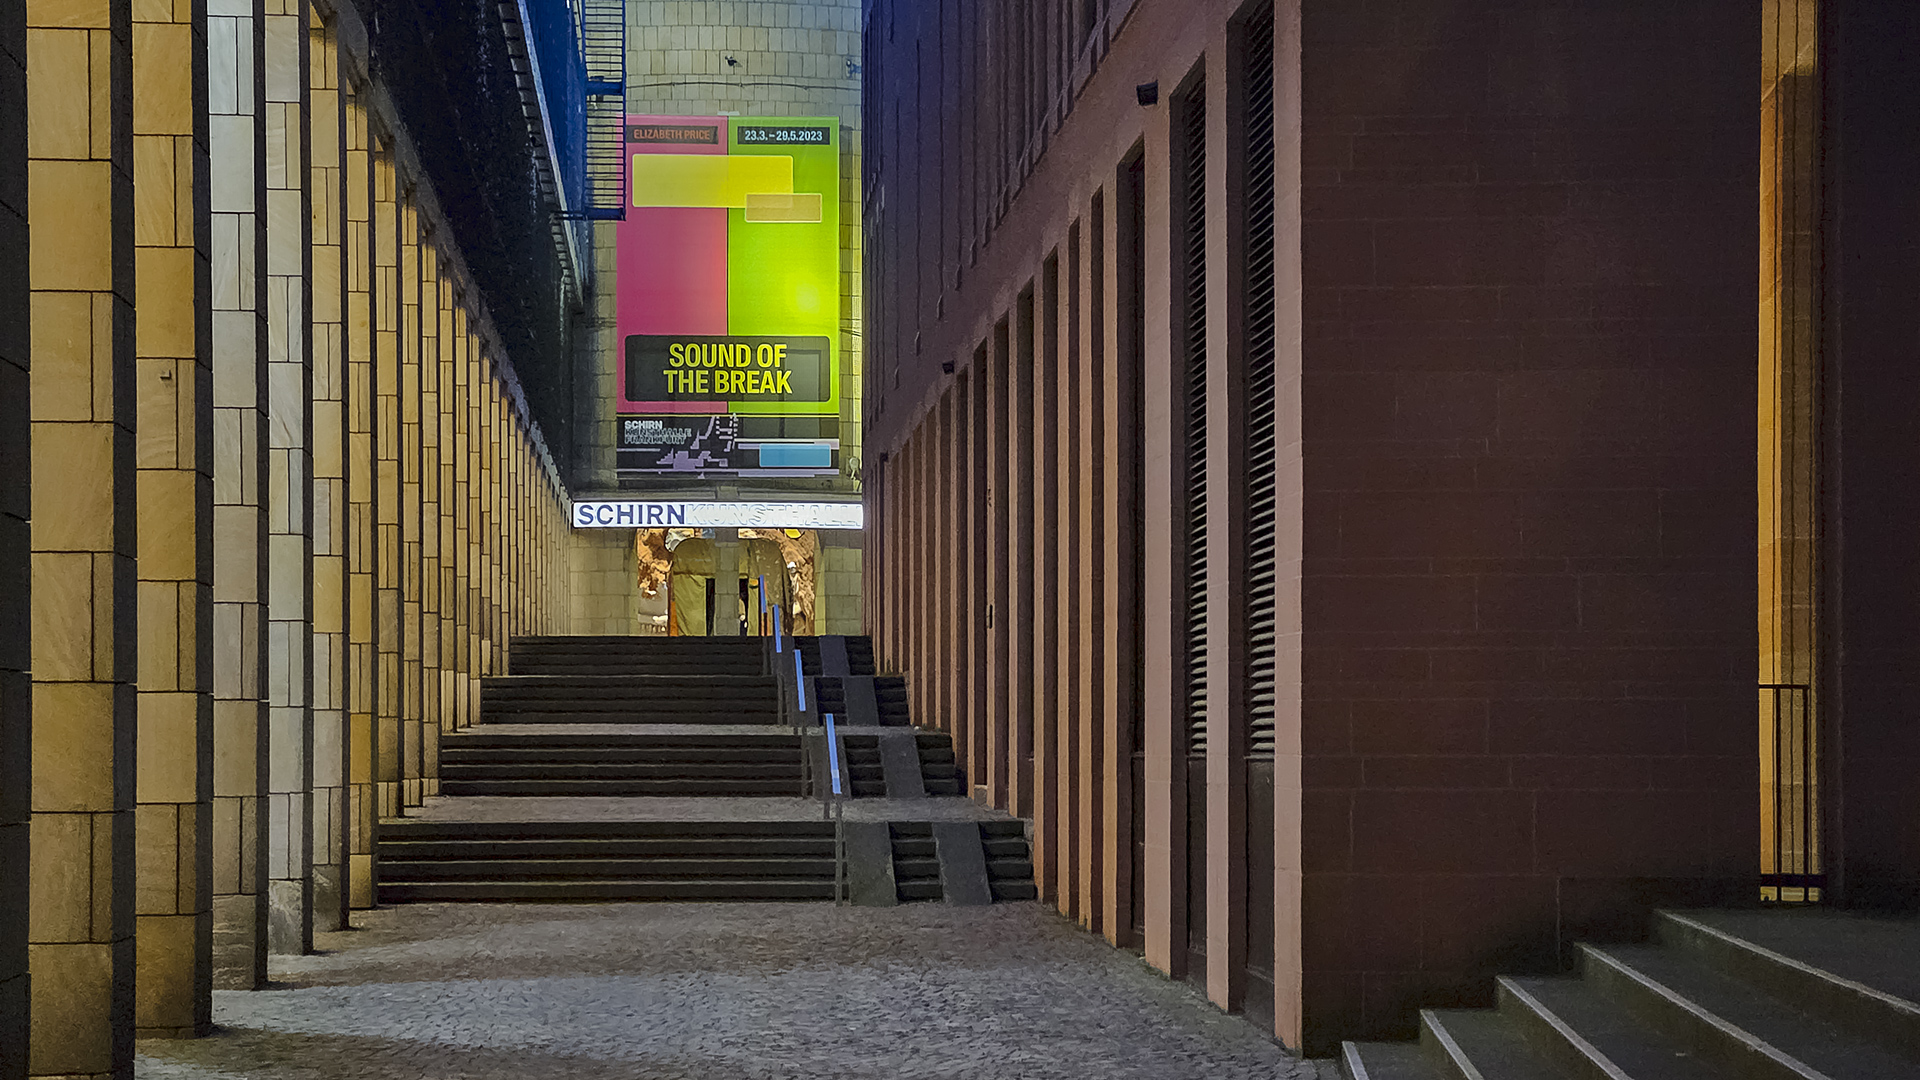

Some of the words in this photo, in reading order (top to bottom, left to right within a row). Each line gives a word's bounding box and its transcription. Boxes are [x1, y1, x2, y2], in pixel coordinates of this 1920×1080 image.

[633, 129, 682, 140] ELIZABETH
[683, 129, 711, 141] PRICE
[669, 343, 751, 368] SOUND
[756, 344, 788, 368] OF
[663, 370, 709, 394] THE
[714, 370, 793, 394] BREAK
[624, 420, 663, 430] SCHIRN
[578, 504, 686, 525] SCHIRN
